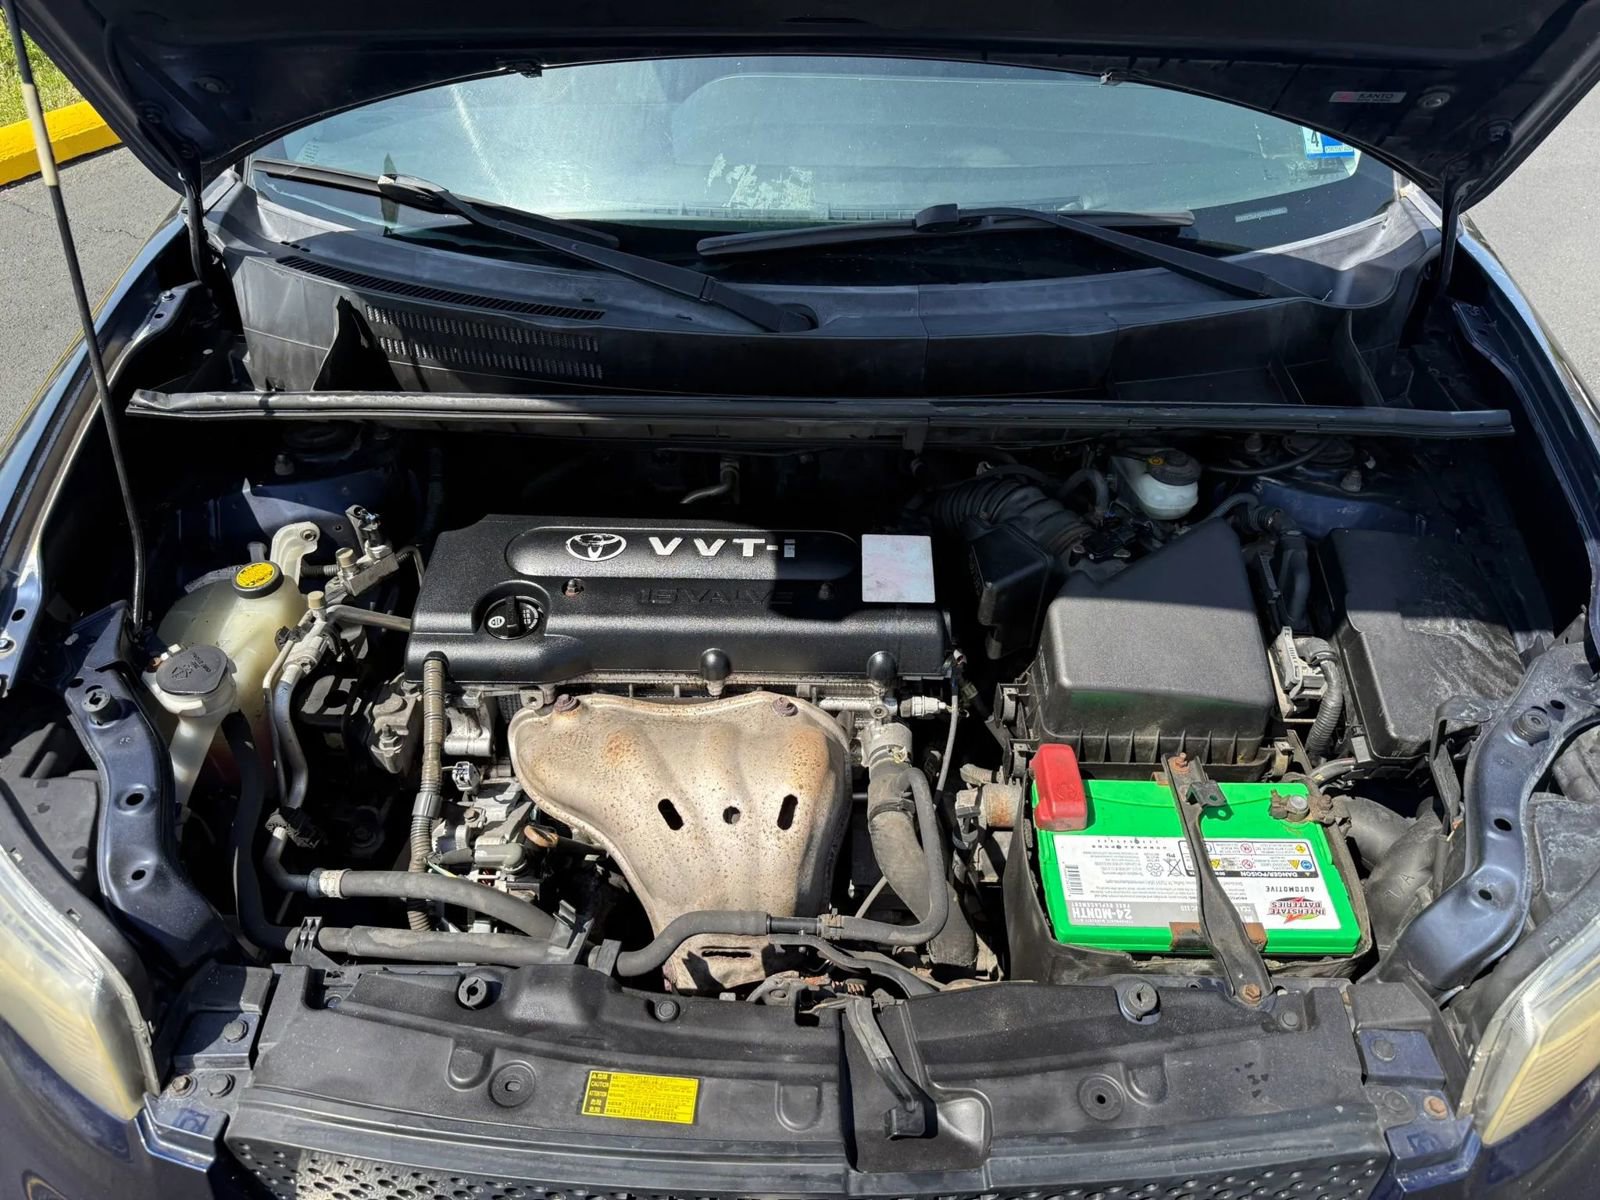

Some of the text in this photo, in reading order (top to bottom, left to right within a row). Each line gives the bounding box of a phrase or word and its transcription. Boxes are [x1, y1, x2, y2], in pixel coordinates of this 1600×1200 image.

[648, 536, 796, 558] VVT-i
[1270, 901, 1322, 909] BATTERIES
[1072, 907, 1132, 920] 24-MONTH
[1268, 907, 1326, 916] INTERSTATE
